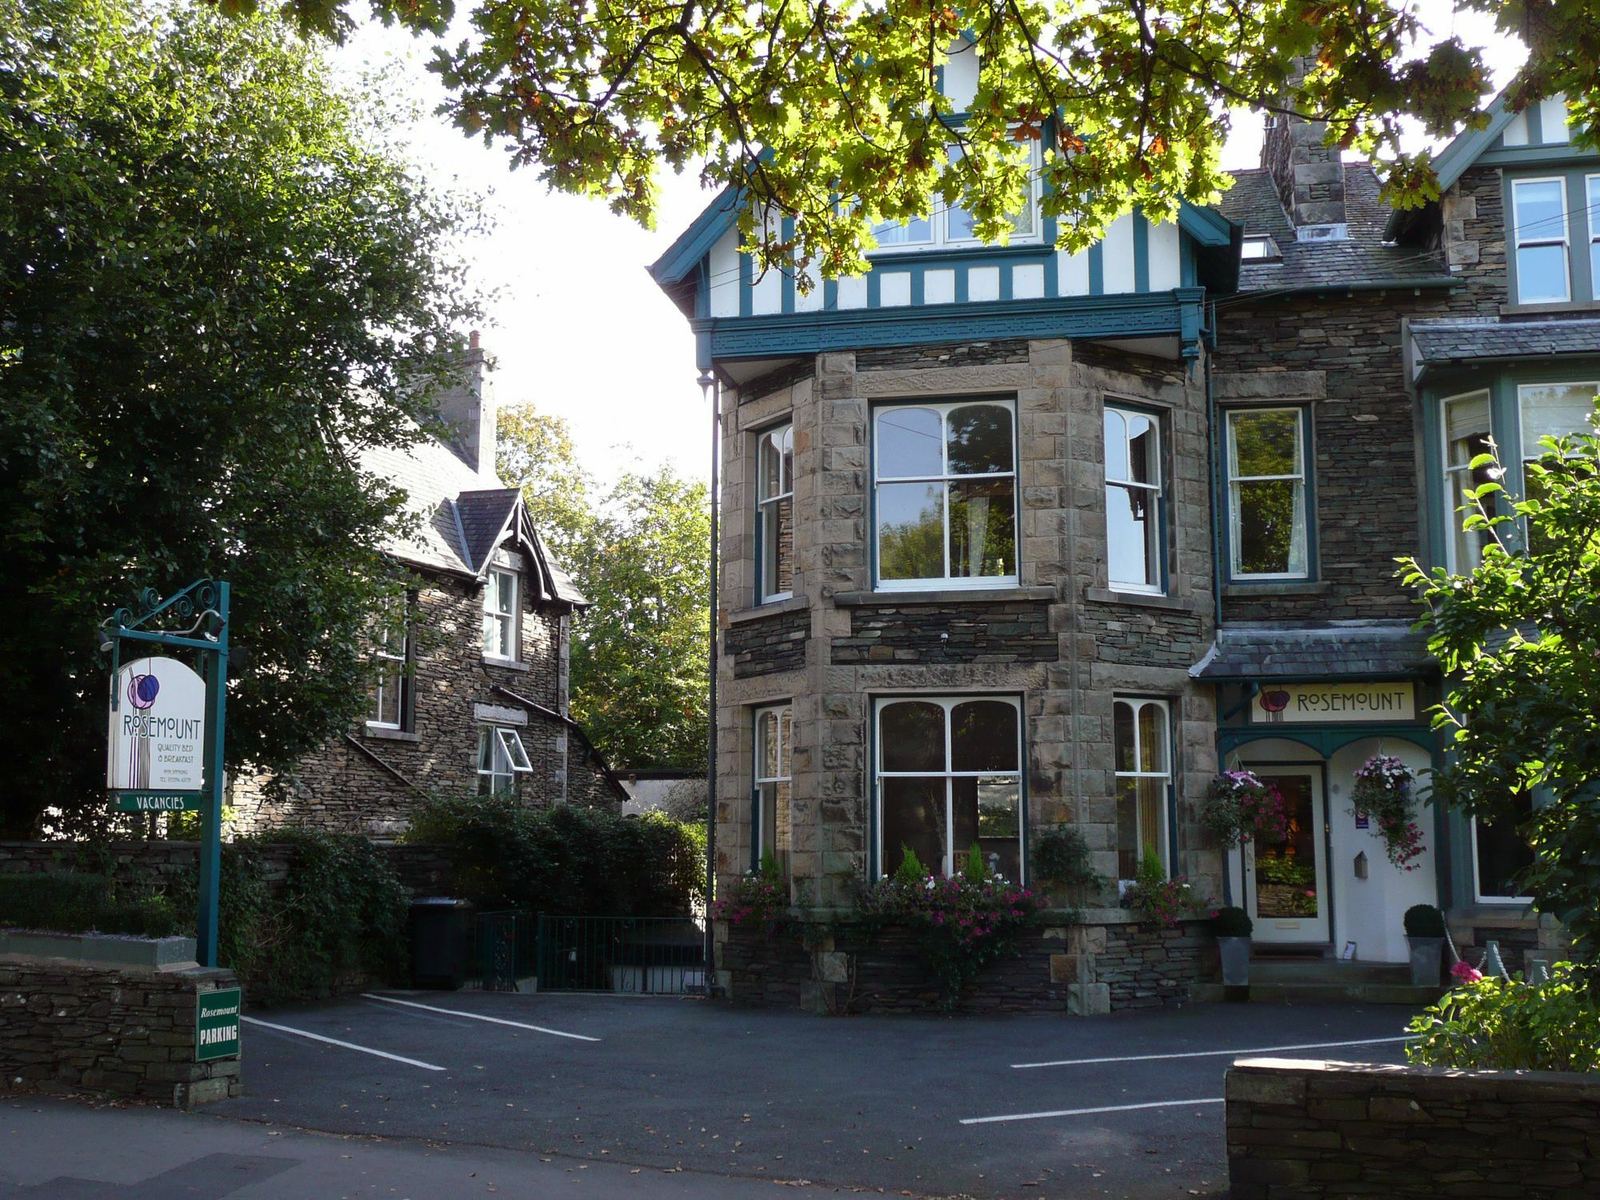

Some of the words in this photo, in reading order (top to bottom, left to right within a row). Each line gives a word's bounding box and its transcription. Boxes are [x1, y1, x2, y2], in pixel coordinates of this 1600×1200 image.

[1297, 692, 1405, 712] ROSEMOUNT
[123, 714, 201, 740] ROSEMOUNT
[157, 743, 180, 752] QUALITY
[181, 744, 194, 752] BED
[164, 755, 194, 763] BREAKFAST
[136, 796, 185, 810] VACANCIES
[200, 1005, 238, 1019] Rosemount
[200, 1025, 238, 1045] PARKING
